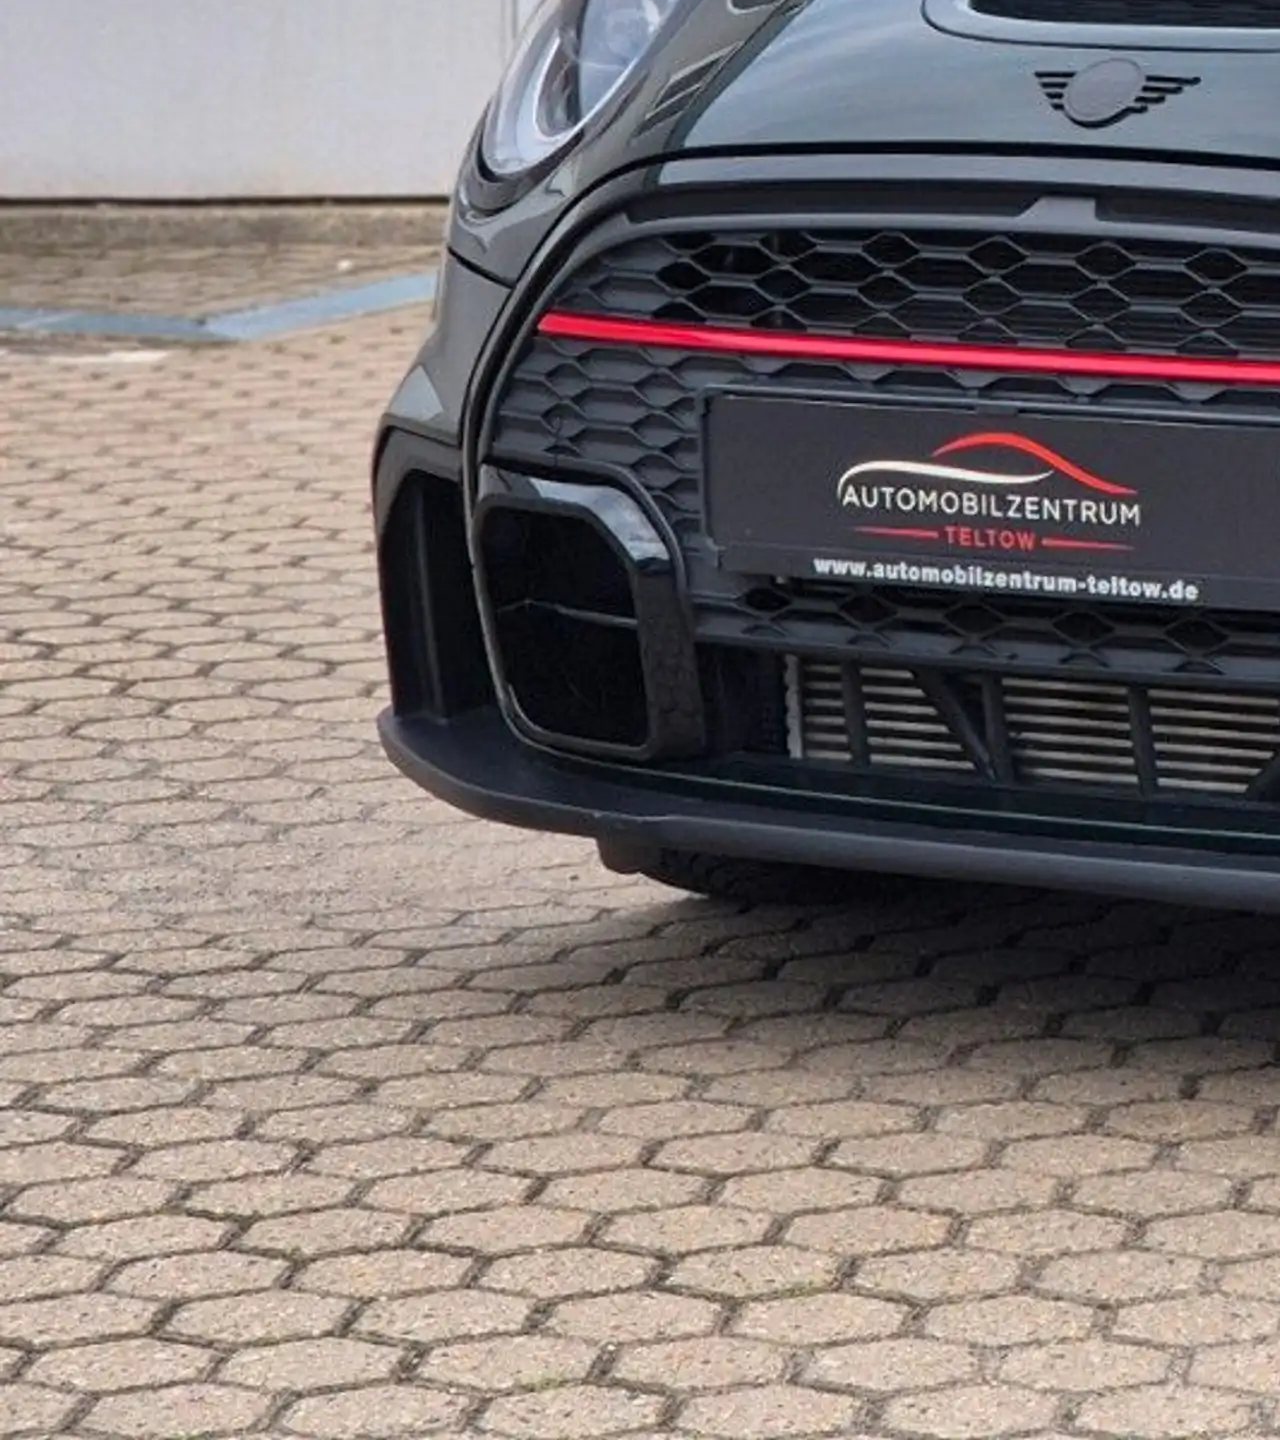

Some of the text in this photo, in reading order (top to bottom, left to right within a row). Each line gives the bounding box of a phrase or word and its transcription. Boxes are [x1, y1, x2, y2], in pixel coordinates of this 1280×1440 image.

[842, 484, 1141, 527] AUTOMOBILZENTRUM
[943, 523, 1037, 552] TELTOW
[812, 557, 1200, 601] www.automobilzentrum-teltow.de
